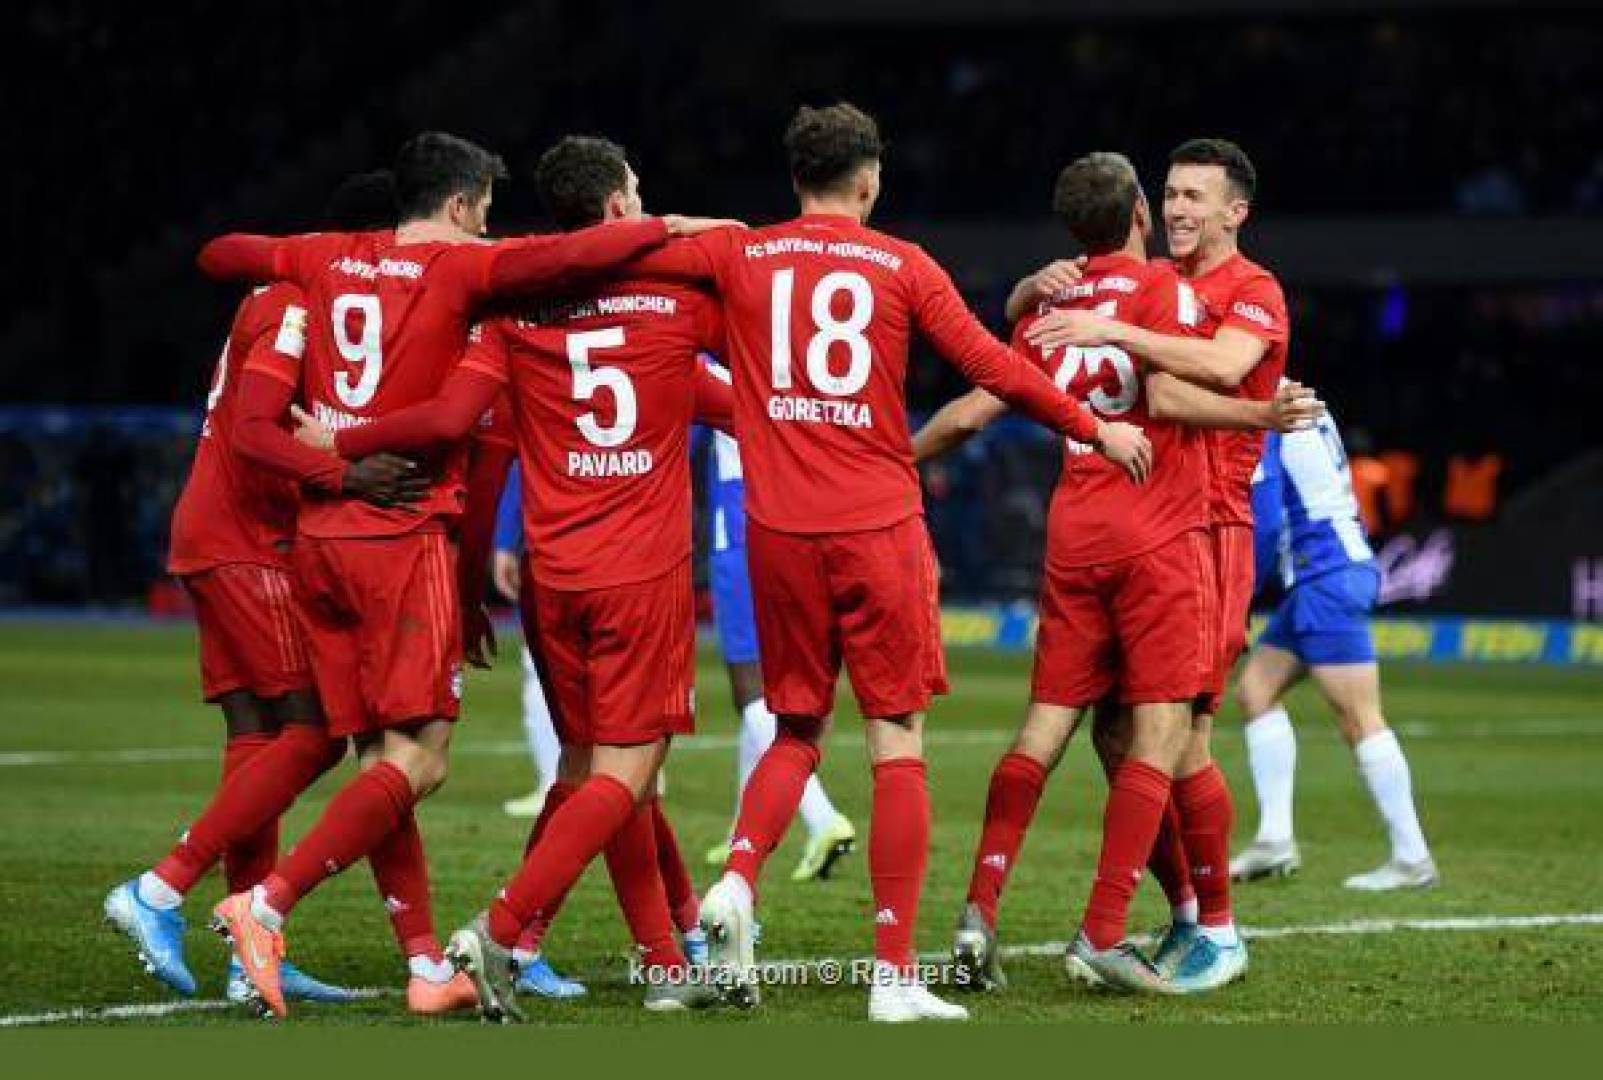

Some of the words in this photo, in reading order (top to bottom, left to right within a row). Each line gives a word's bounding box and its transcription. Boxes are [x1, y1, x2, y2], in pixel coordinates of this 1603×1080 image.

[744, 244, 764, 259] FC
[331, 293, 383, 408] 9
[771, 266, 875, 397] 18
[565, 326, 637, 447] 5
[768, 396, 873, 429] GORETZKA
[567, 449, 653, 477] PAVARD
